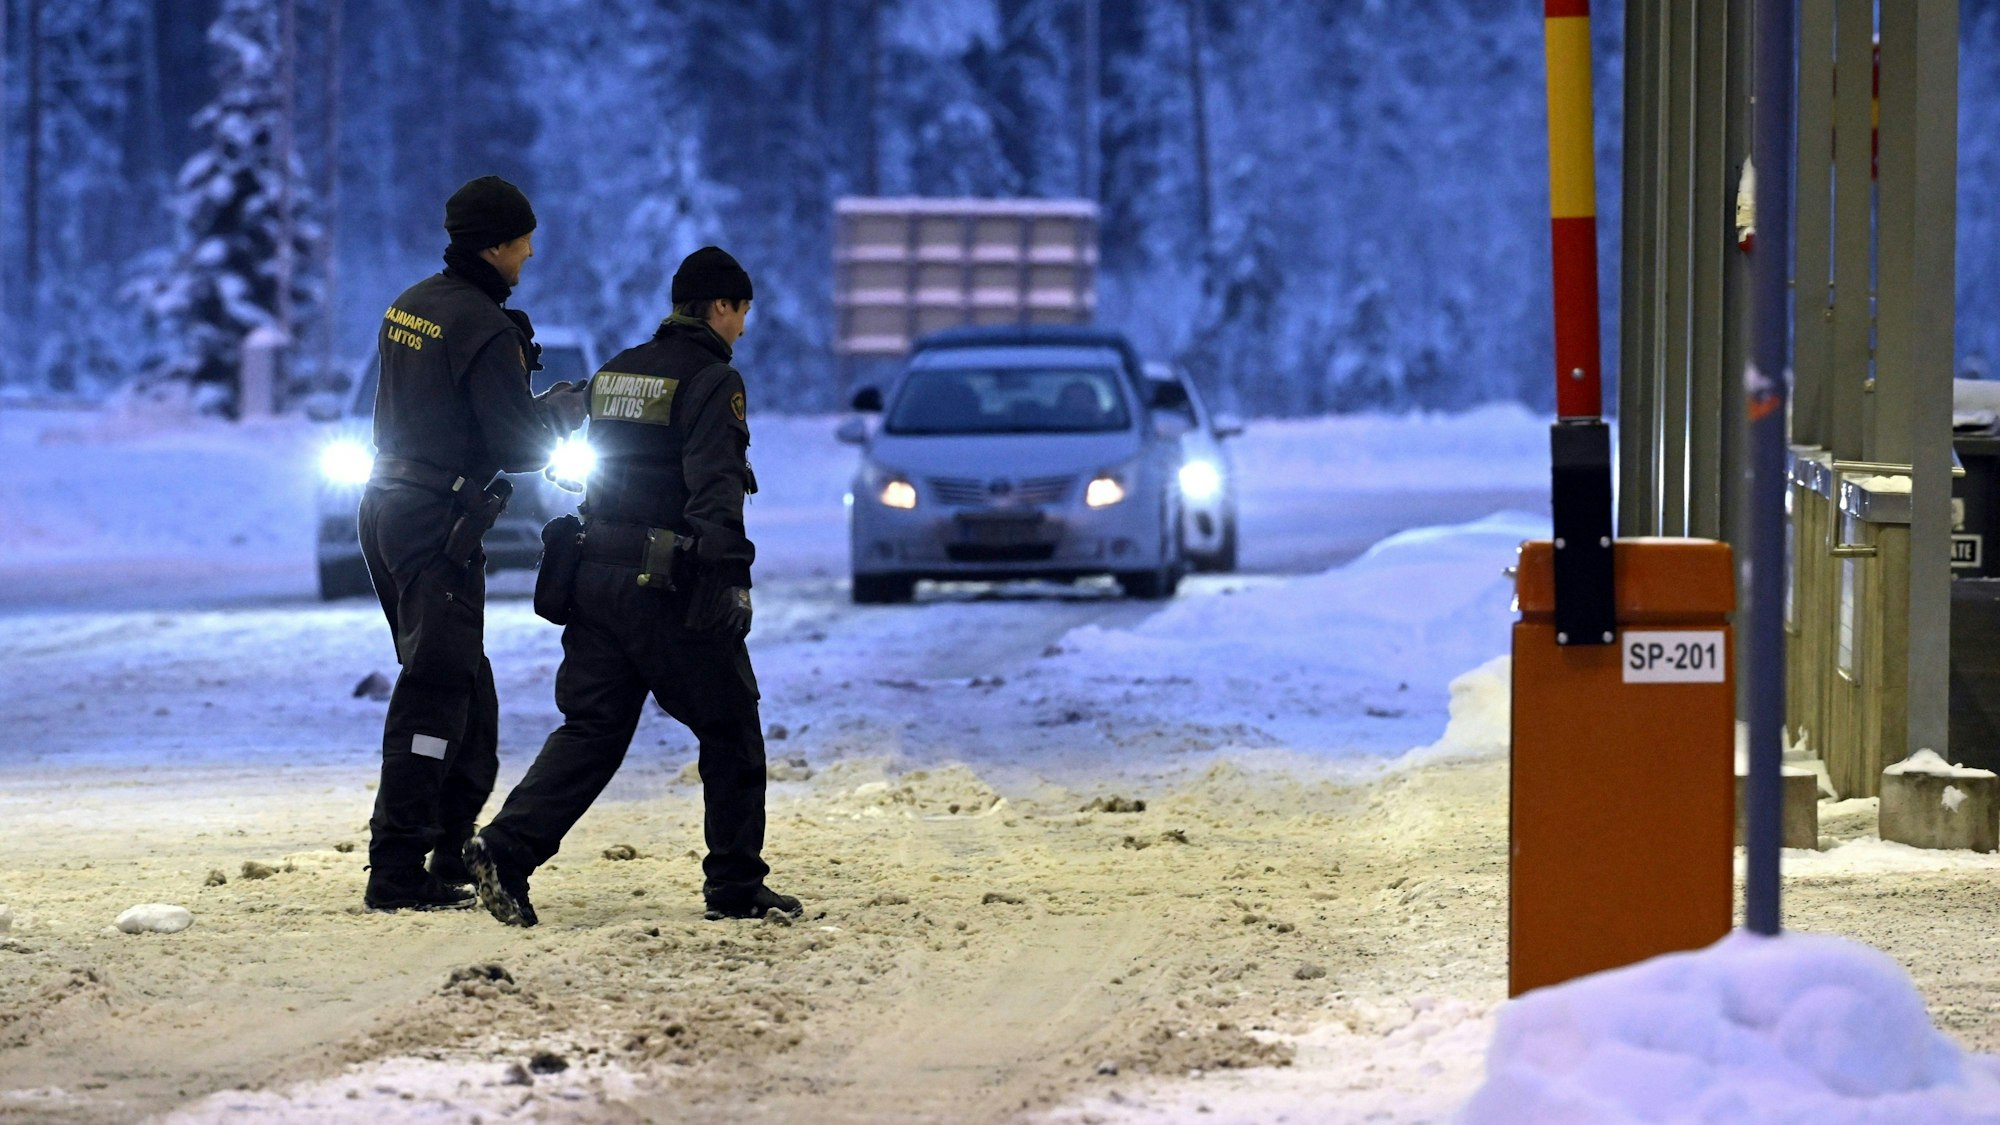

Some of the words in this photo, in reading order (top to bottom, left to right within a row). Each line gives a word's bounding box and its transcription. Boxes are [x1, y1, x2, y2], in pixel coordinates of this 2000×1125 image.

[388, 326, 422, 350] LAITOS
[595, 375, 667, 398] RAJAVARTIO-
[602, 396, 644, 418] LAITOS
[1629, 642, 1715, 669] SP-201
